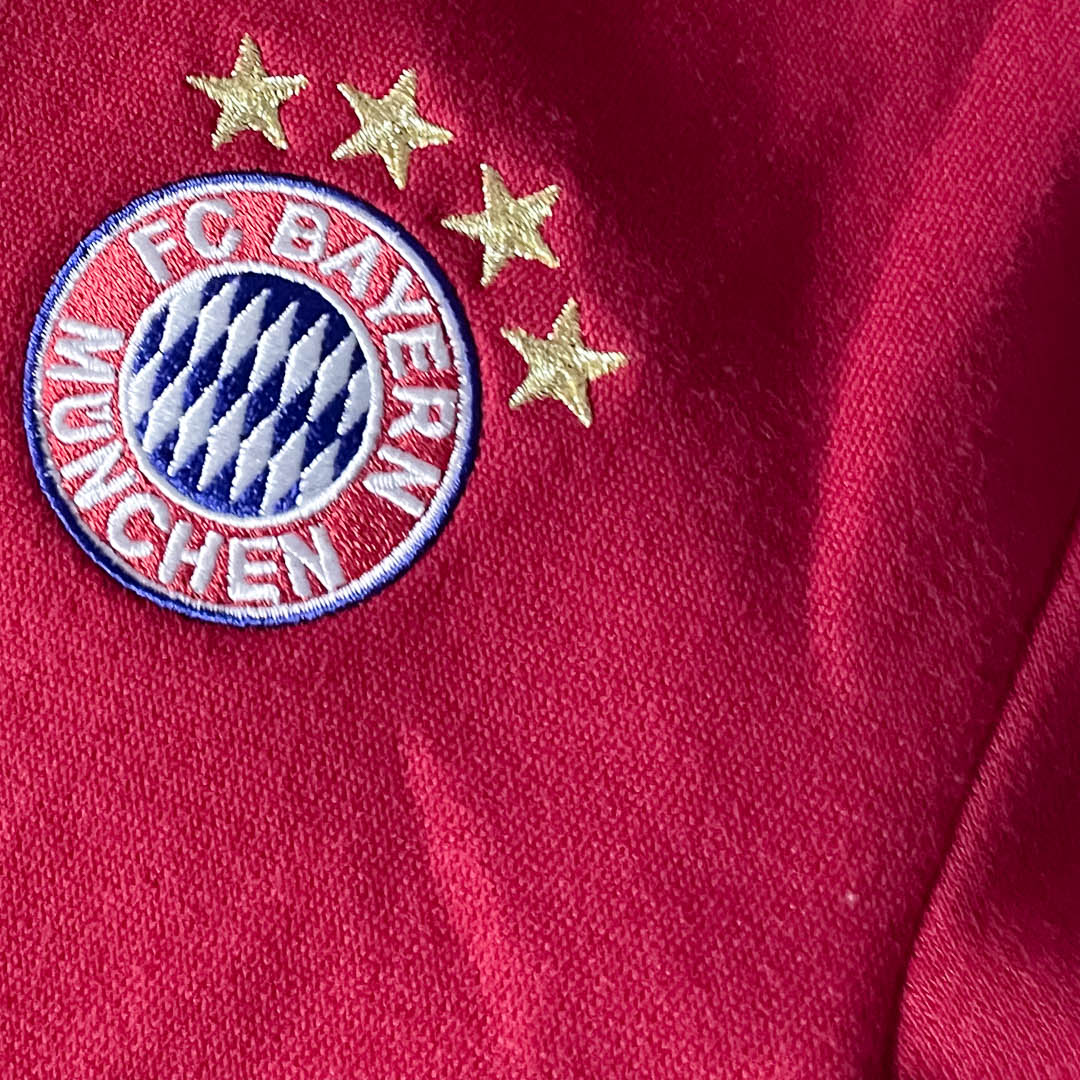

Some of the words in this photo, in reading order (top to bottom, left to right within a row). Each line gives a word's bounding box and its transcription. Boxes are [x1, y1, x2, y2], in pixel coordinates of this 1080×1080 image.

[46, 319, 346, 605] MÜNCHEN
[128, 199, 242, 284] FC
[271, 201, 458, 518] BAYERN
